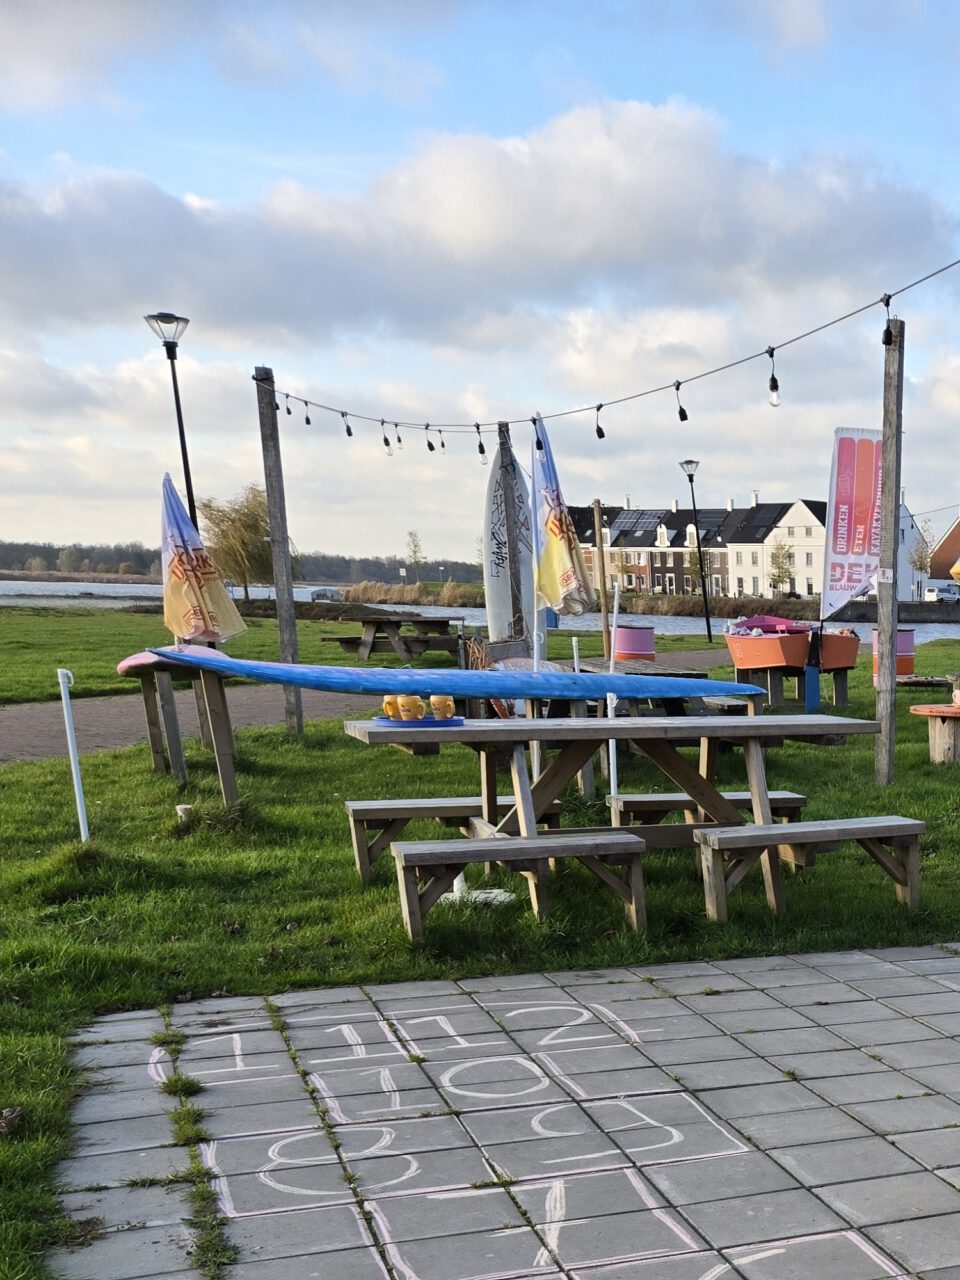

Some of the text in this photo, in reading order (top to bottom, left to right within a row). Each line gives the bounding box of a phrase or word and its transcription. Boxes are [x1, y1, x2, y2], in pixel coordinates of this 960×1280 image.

[836, 504, 849, 553] DRINKEN
[853, 524, 865, 553] ETEN
[405, 1006, 664, 1048] 12
[357, 1055, 550, 1115] 10
[530, 1100, 685, 1164] 9
[256, 1131, 422, 1195] 8
[427, 1179, 592, 1267] 7
